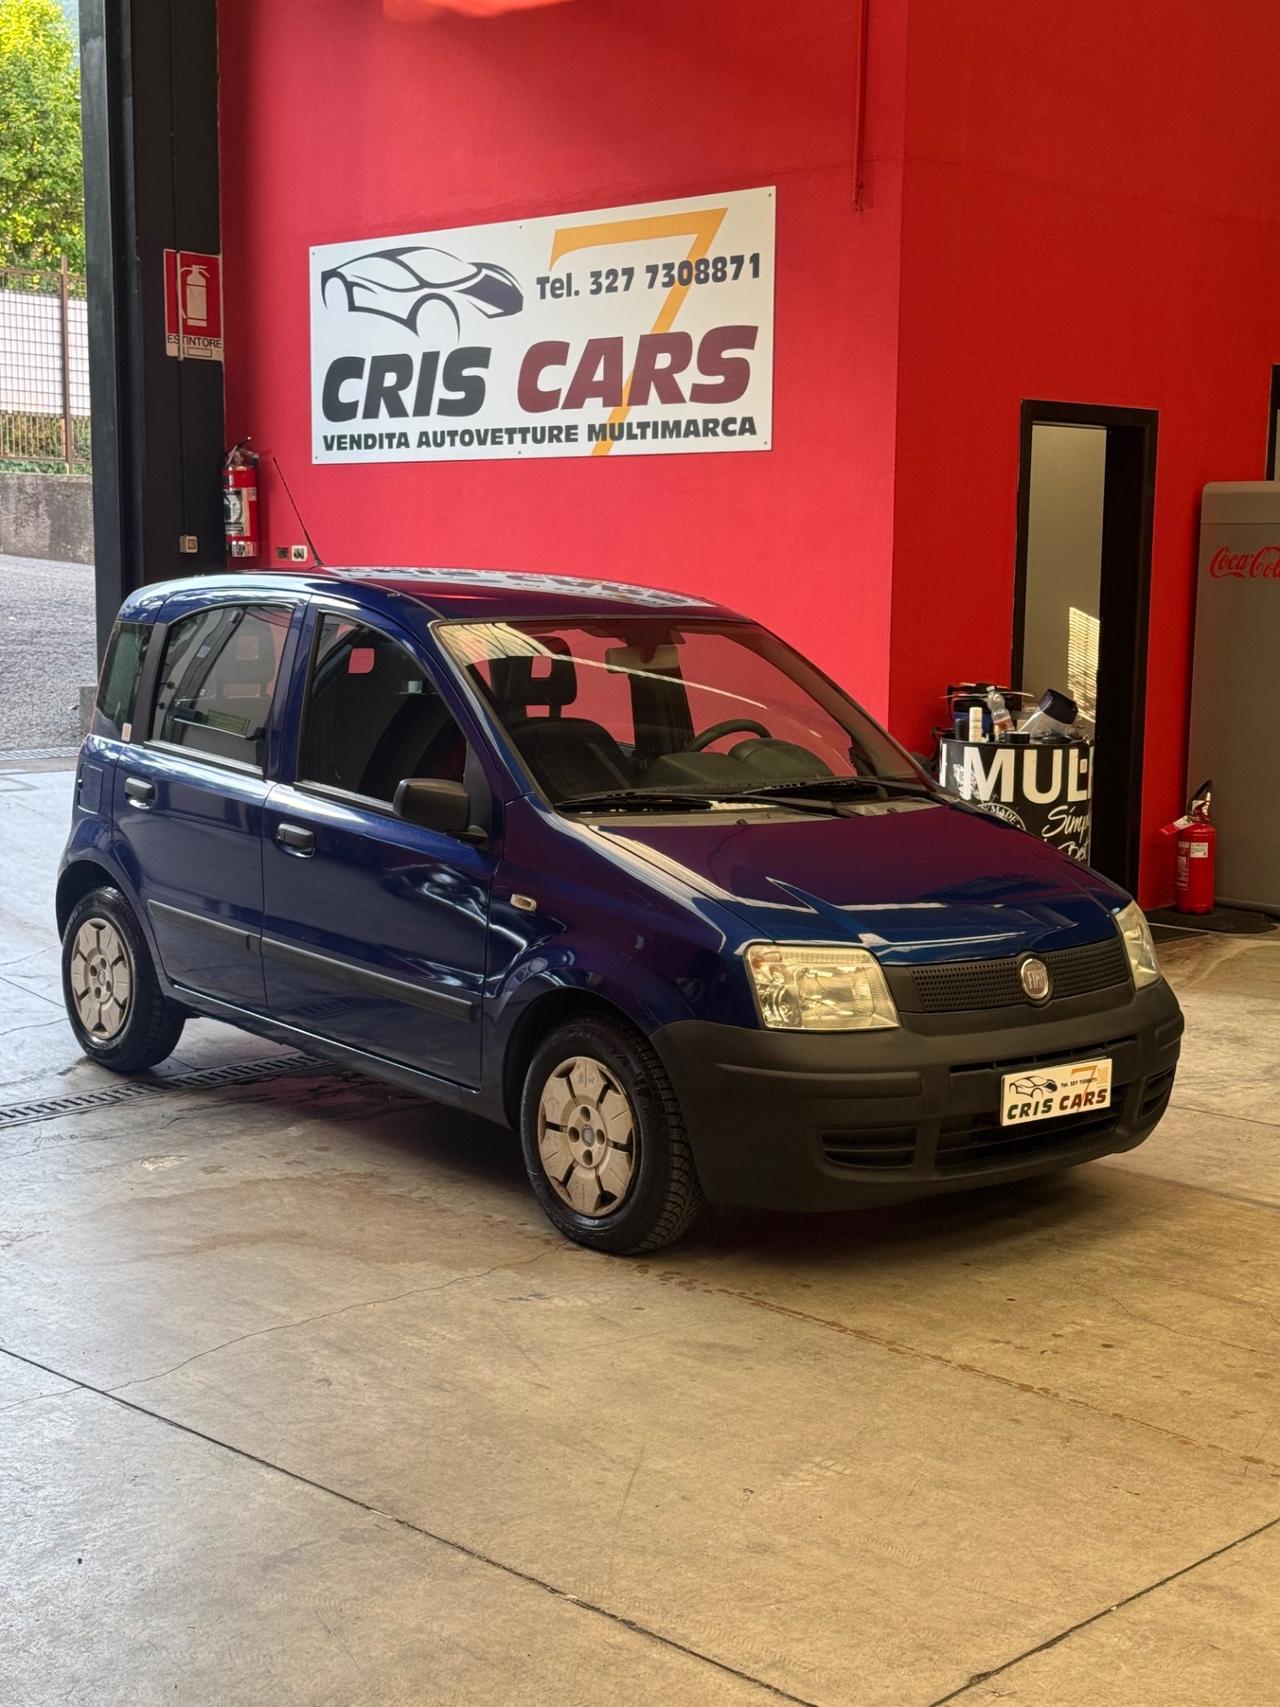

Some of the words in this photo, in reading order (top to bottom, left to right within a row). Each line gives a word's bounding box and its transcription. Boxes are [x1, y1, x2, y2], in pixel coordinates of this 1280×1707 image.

[536, 275, 580, 300] Tel.
[589, 267, 635, 296] 327
[645, 252, 761, 290] 7308871
[168, 335, 222, 348] ESTINTORE
[321, 346, 492, 423] CRIS
[517, 325, 759, 414] CARS
[322, 431, 410, 452] VENDITA
[416, 424, 579, 450] AUTOVETTURE
[587, 416, 757, 443] MULTIMARCA
[1209, 545, 1280, 578] Coca-Col
[1007, 1098, 1054, 1120] CRIS
[1058, 1088, 1107, 1111] CARS
